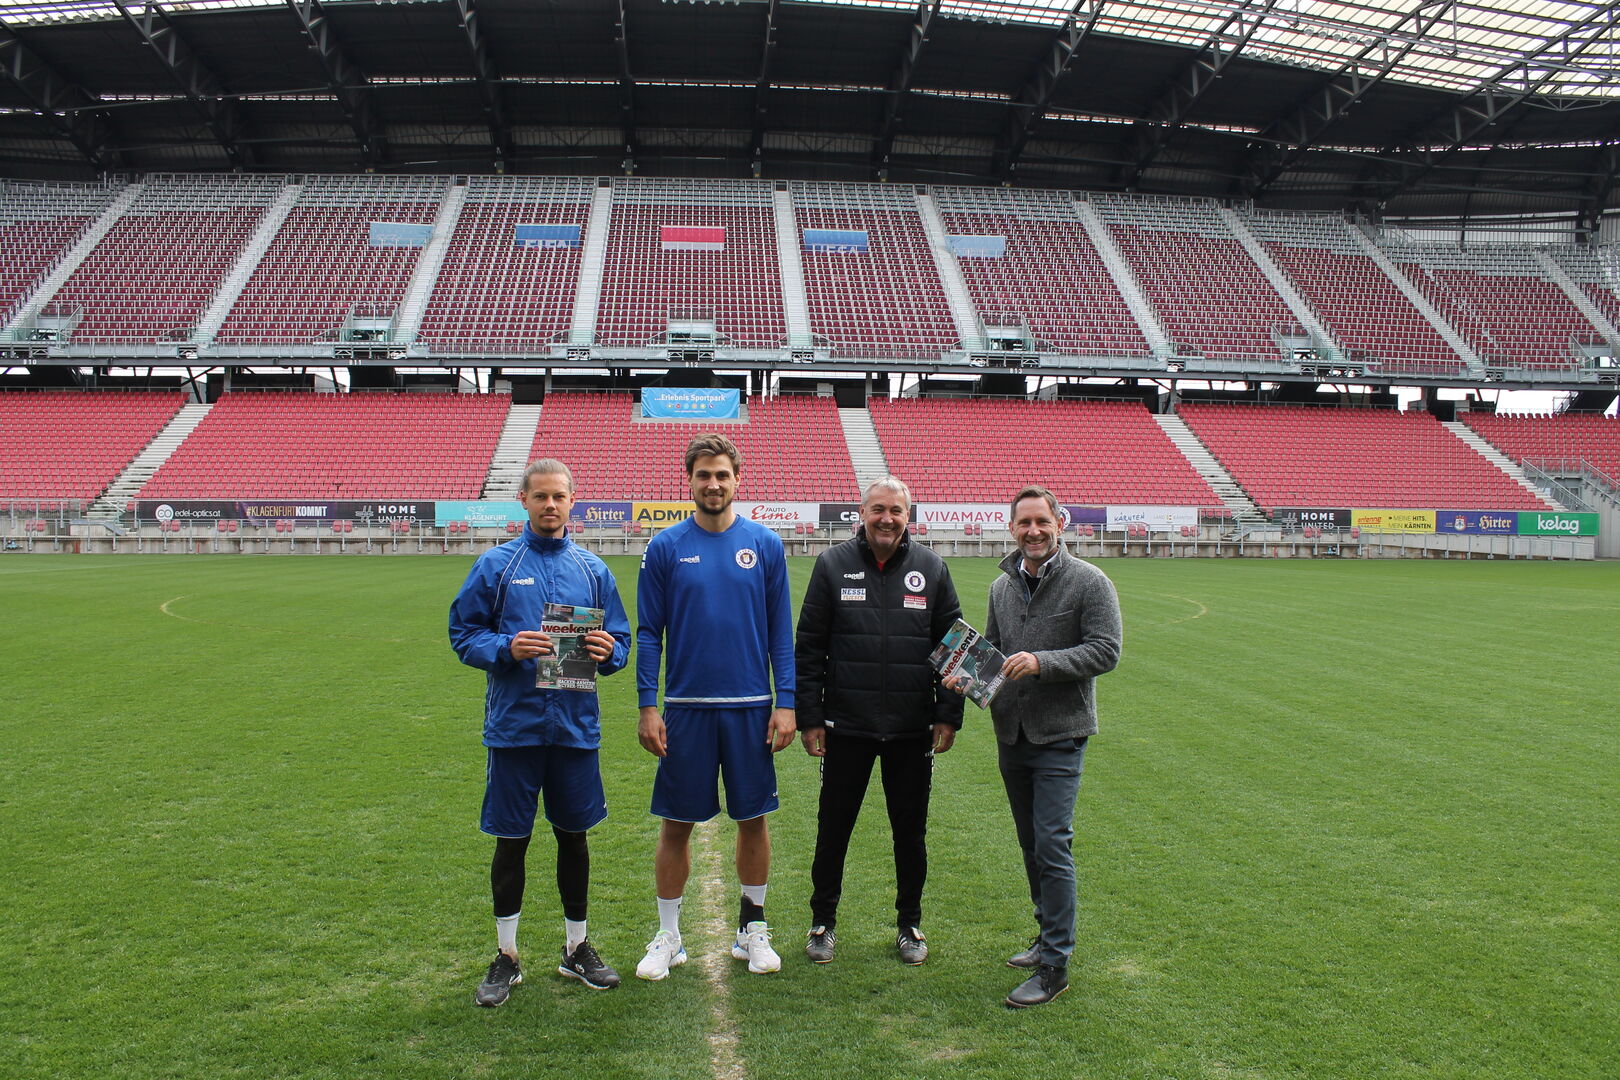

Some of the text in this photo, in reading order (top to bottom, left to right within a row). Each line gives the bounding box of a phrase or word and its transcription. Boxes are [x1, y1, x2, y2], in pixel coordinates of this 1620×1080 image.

[690, 393, 726, 403] Sportpark
[174, 509, 221, 519] edel-optics.at
[246, 506, 328, 517] #KLAGENFURTKOMMT
[378, 505, 416, 514] HOME
[585, 506, 625, 521] Hirter
[751, 504, 800, 521] Eisner
[378, 515, 416, 523] UNITED
[924, 511, 1005, 522] VIVAMAYR
[1301, 512, 1335, 521] HOME
[1479, 515, 1512, 529] Hirter
[1537, 514, 1580, 534] kelag
[942, 628, 977, 677] weekend
